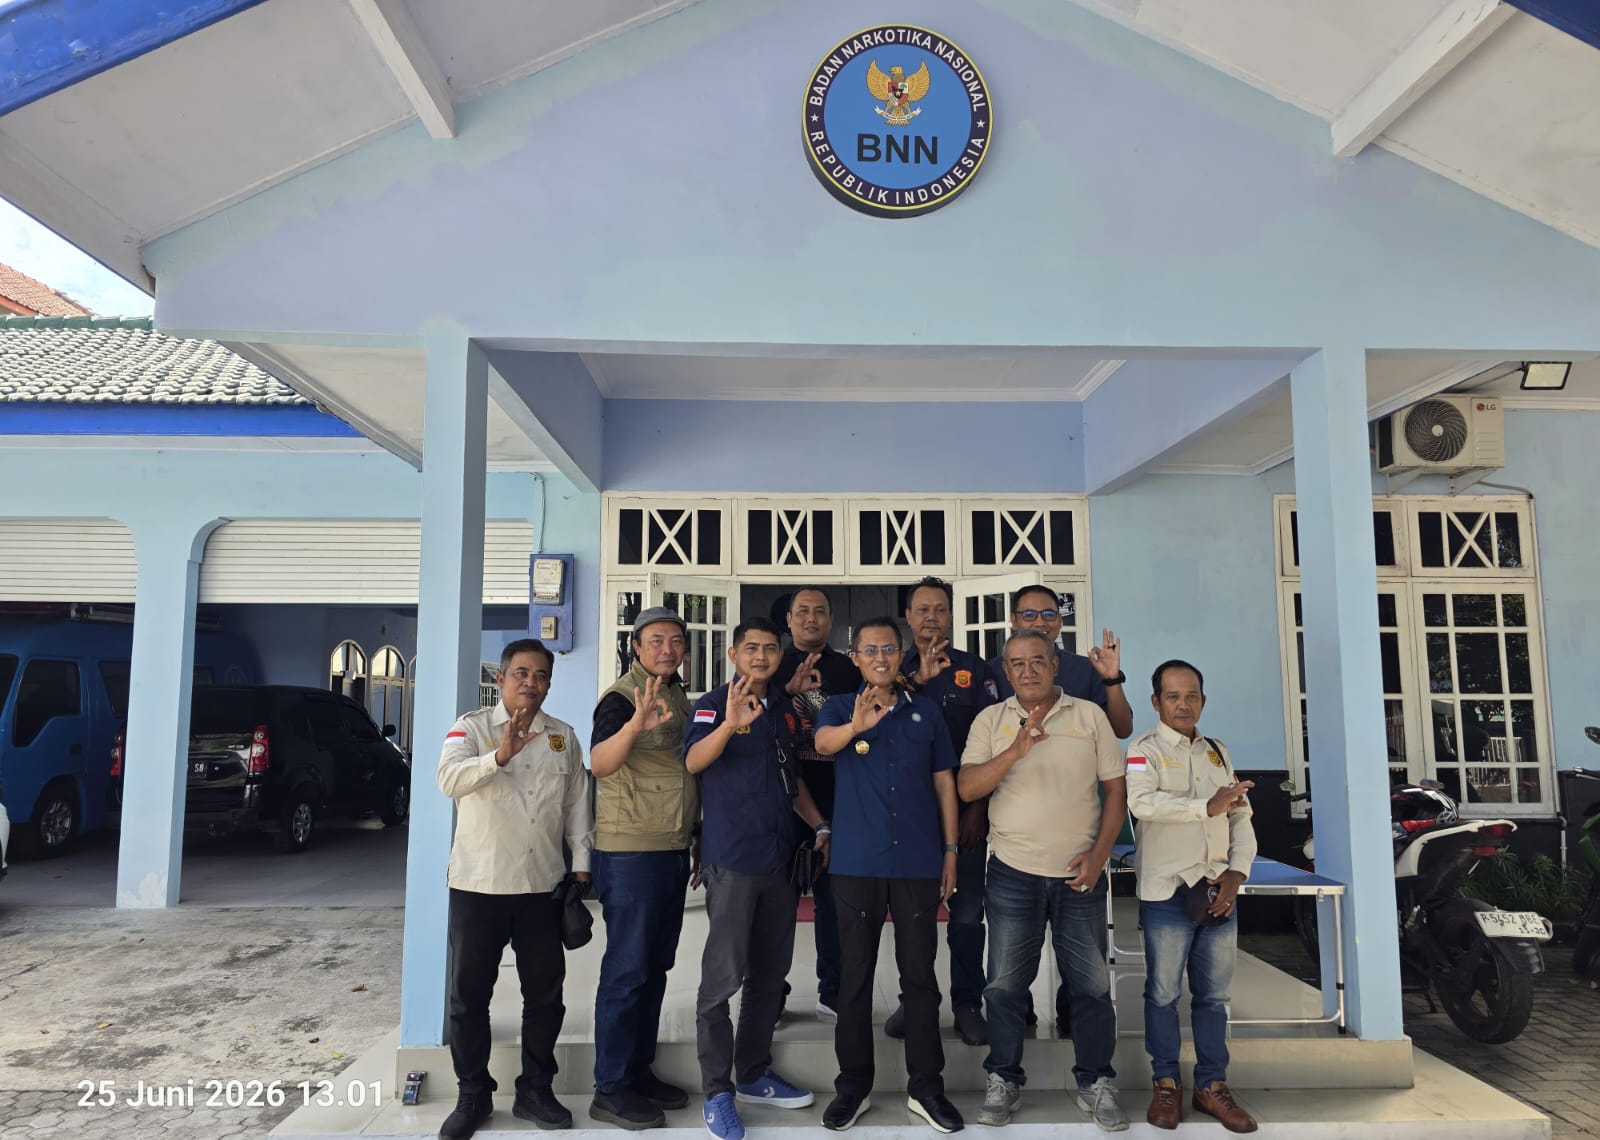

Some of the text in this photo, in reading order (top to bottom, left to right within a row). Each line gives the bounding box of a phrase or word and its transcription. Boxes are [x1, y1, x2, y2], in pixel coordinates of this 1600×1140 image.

[809, 29, 986, 112] BADAN NARKOTIKA NASIONAL
[810, 130, 985, 205] REPUBLIK INDONESIA
[857, 133, 938, 165] BNN
